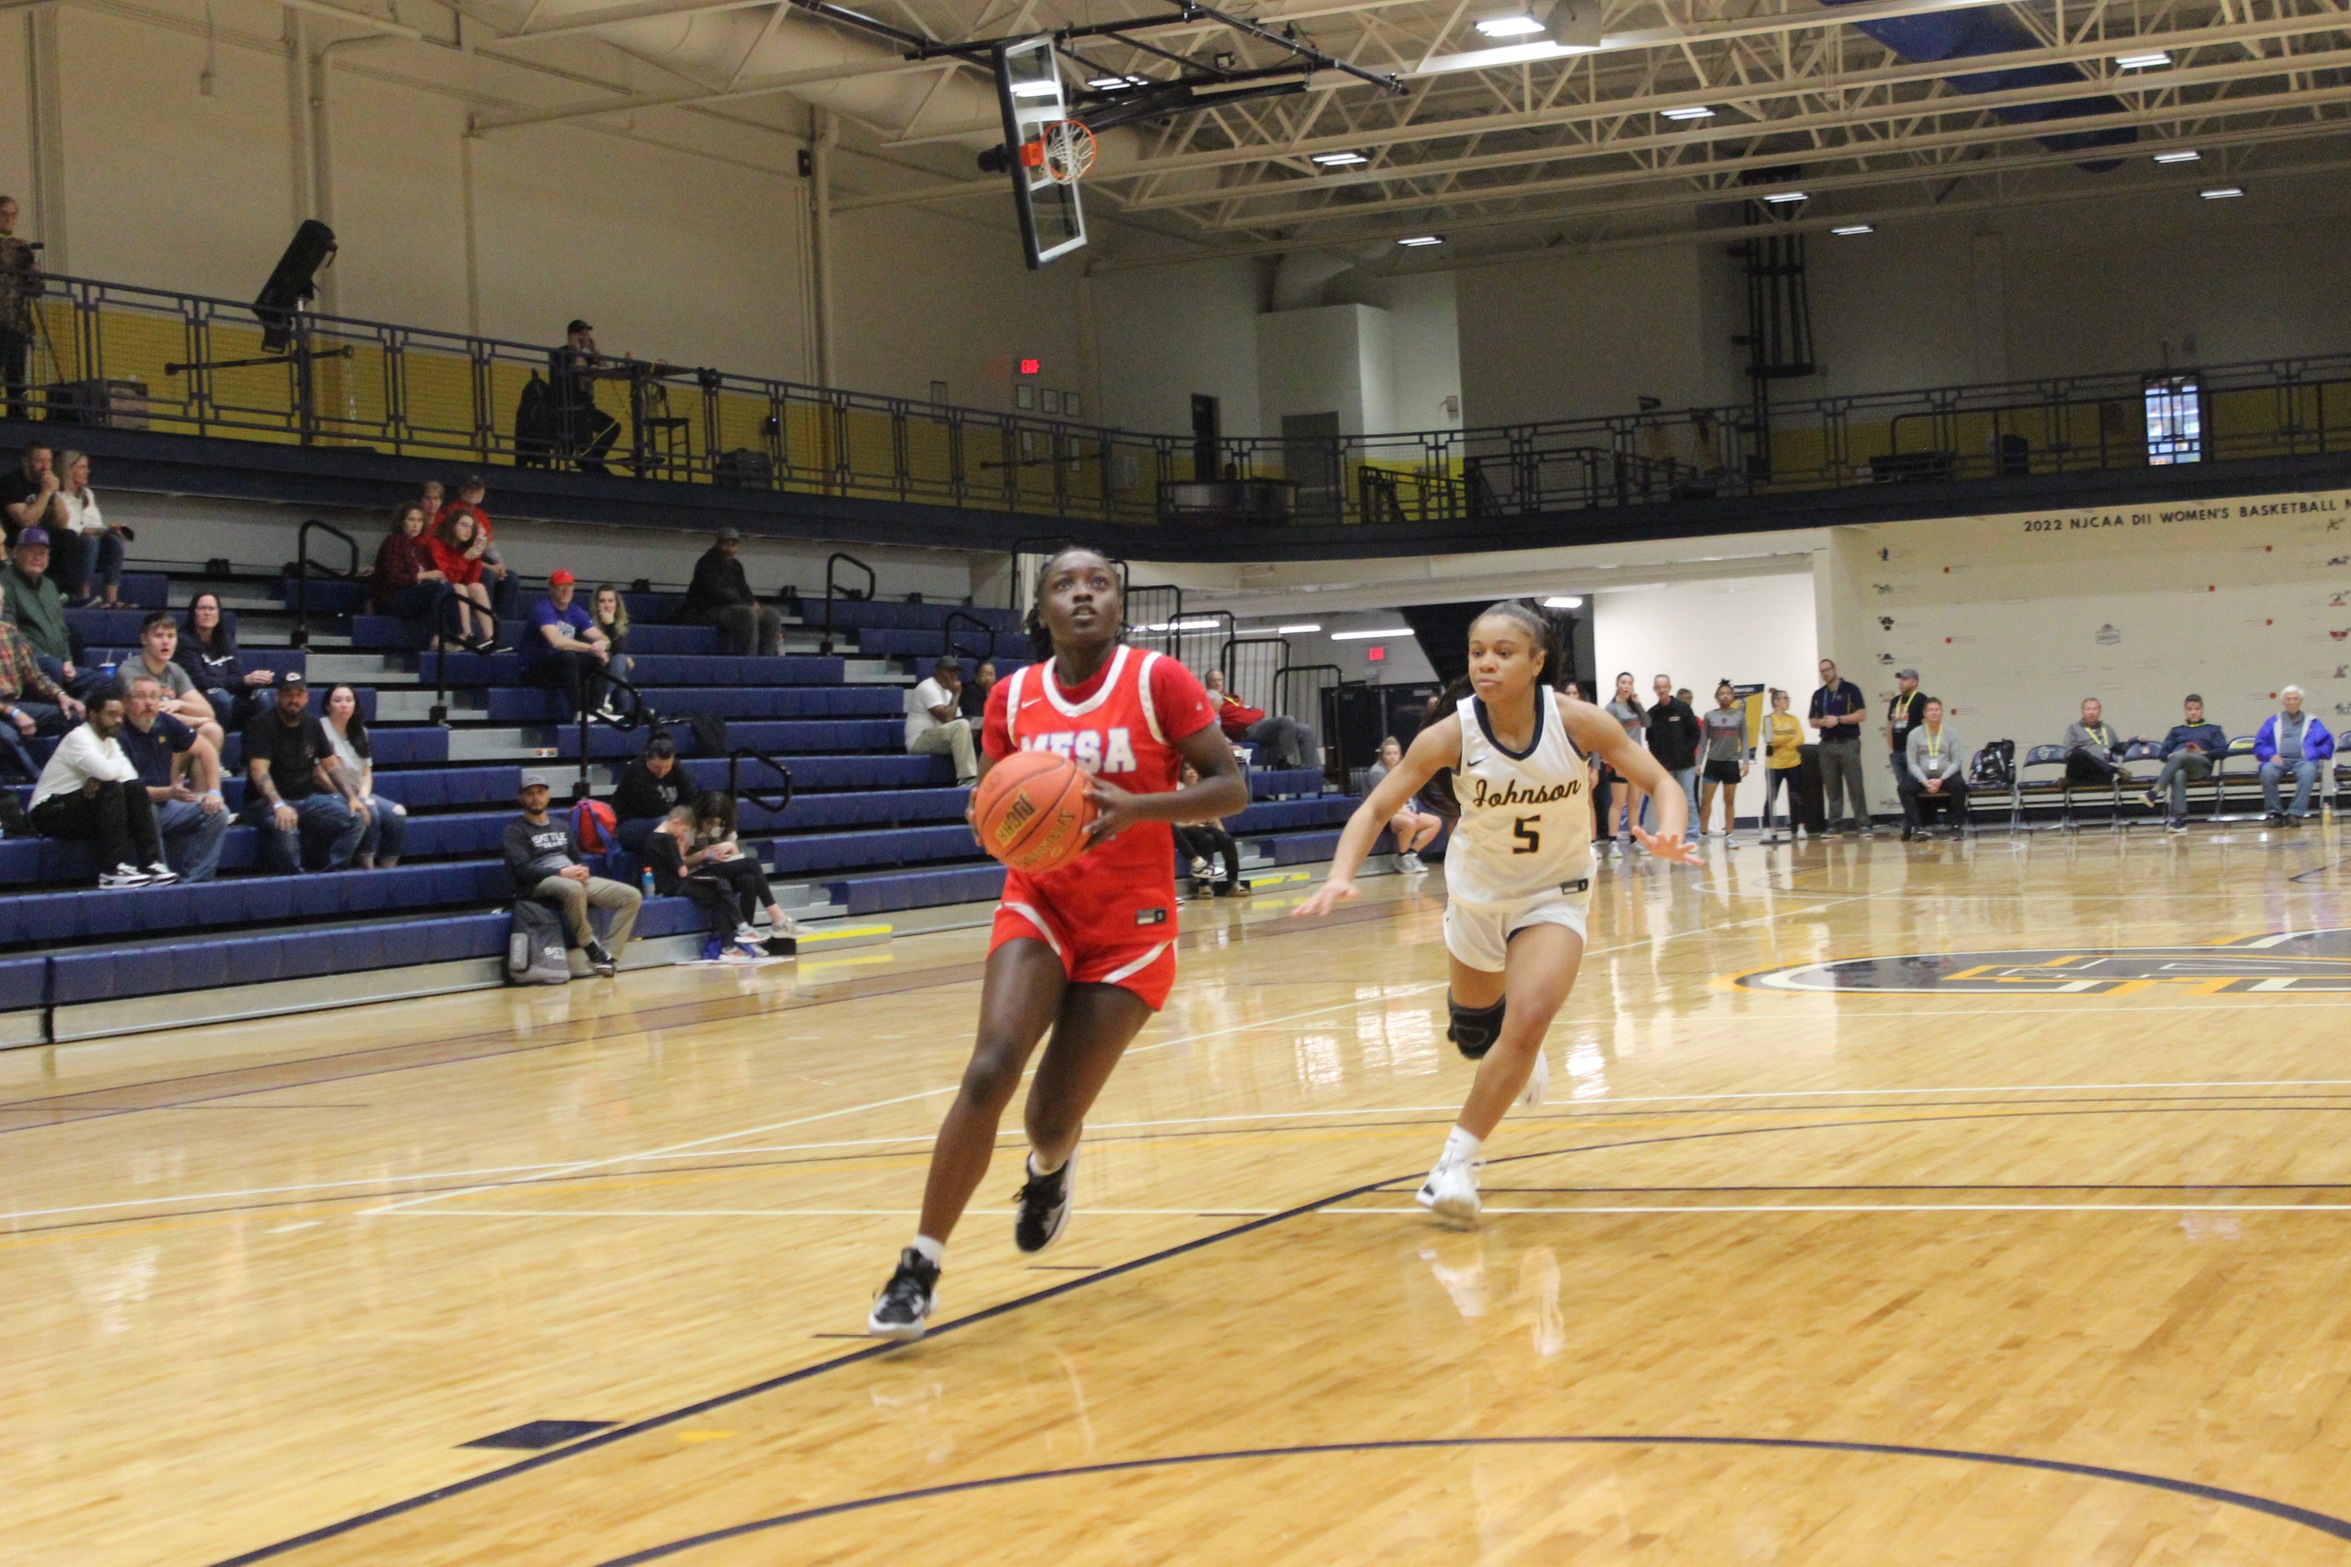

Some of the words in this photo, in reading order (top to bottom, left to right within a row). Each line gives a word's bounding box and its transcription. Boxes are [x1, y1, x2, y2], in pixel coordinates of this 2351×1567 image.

[2023, 519, 2063, 532] 2022
[2070, 514, 2124, 529] NJCAA
[2159, 507, 2230, 524] WOMEN'S
[2239, 498, 2337, 518] BASKETBALL
[1473, 778, 1582, 808] Johnson
[1512, 814, 1541, 855] 5
